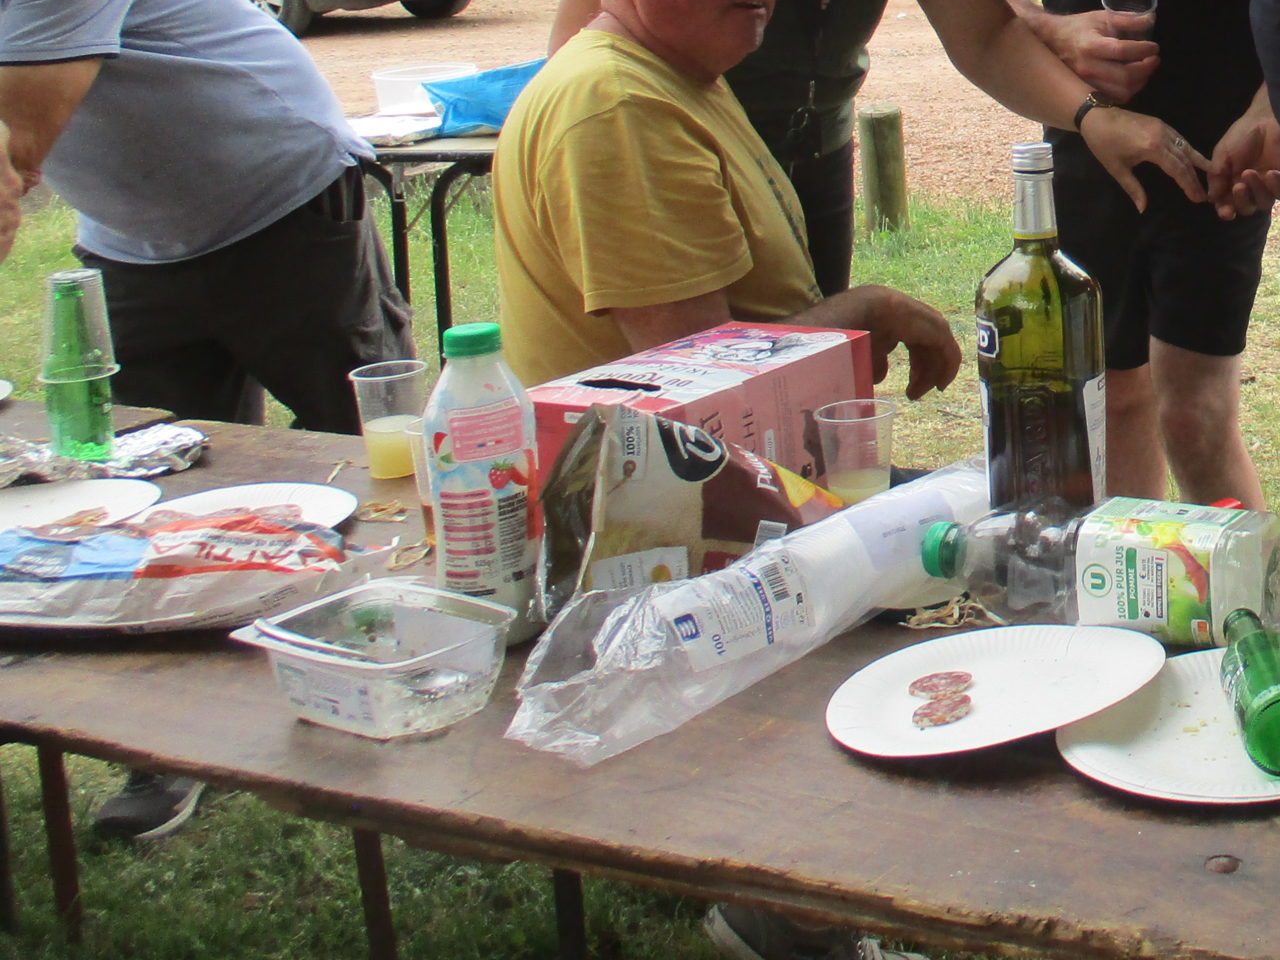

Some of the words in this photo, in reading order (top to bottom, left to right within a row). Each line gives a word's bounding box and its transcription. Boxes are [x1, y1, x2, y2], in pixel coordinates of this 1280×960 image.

[624, 426, 637, 457] 100%
[1115, 545, 1125, 566] JUS
[1090, 572, 1106, 590] U
[1116, 566, 1126, 589] PUR
[1128, 568, 1137, 600] POMME
[1117, 592, 1127, 620] 100%
[711, 631, 725, 657] 100
